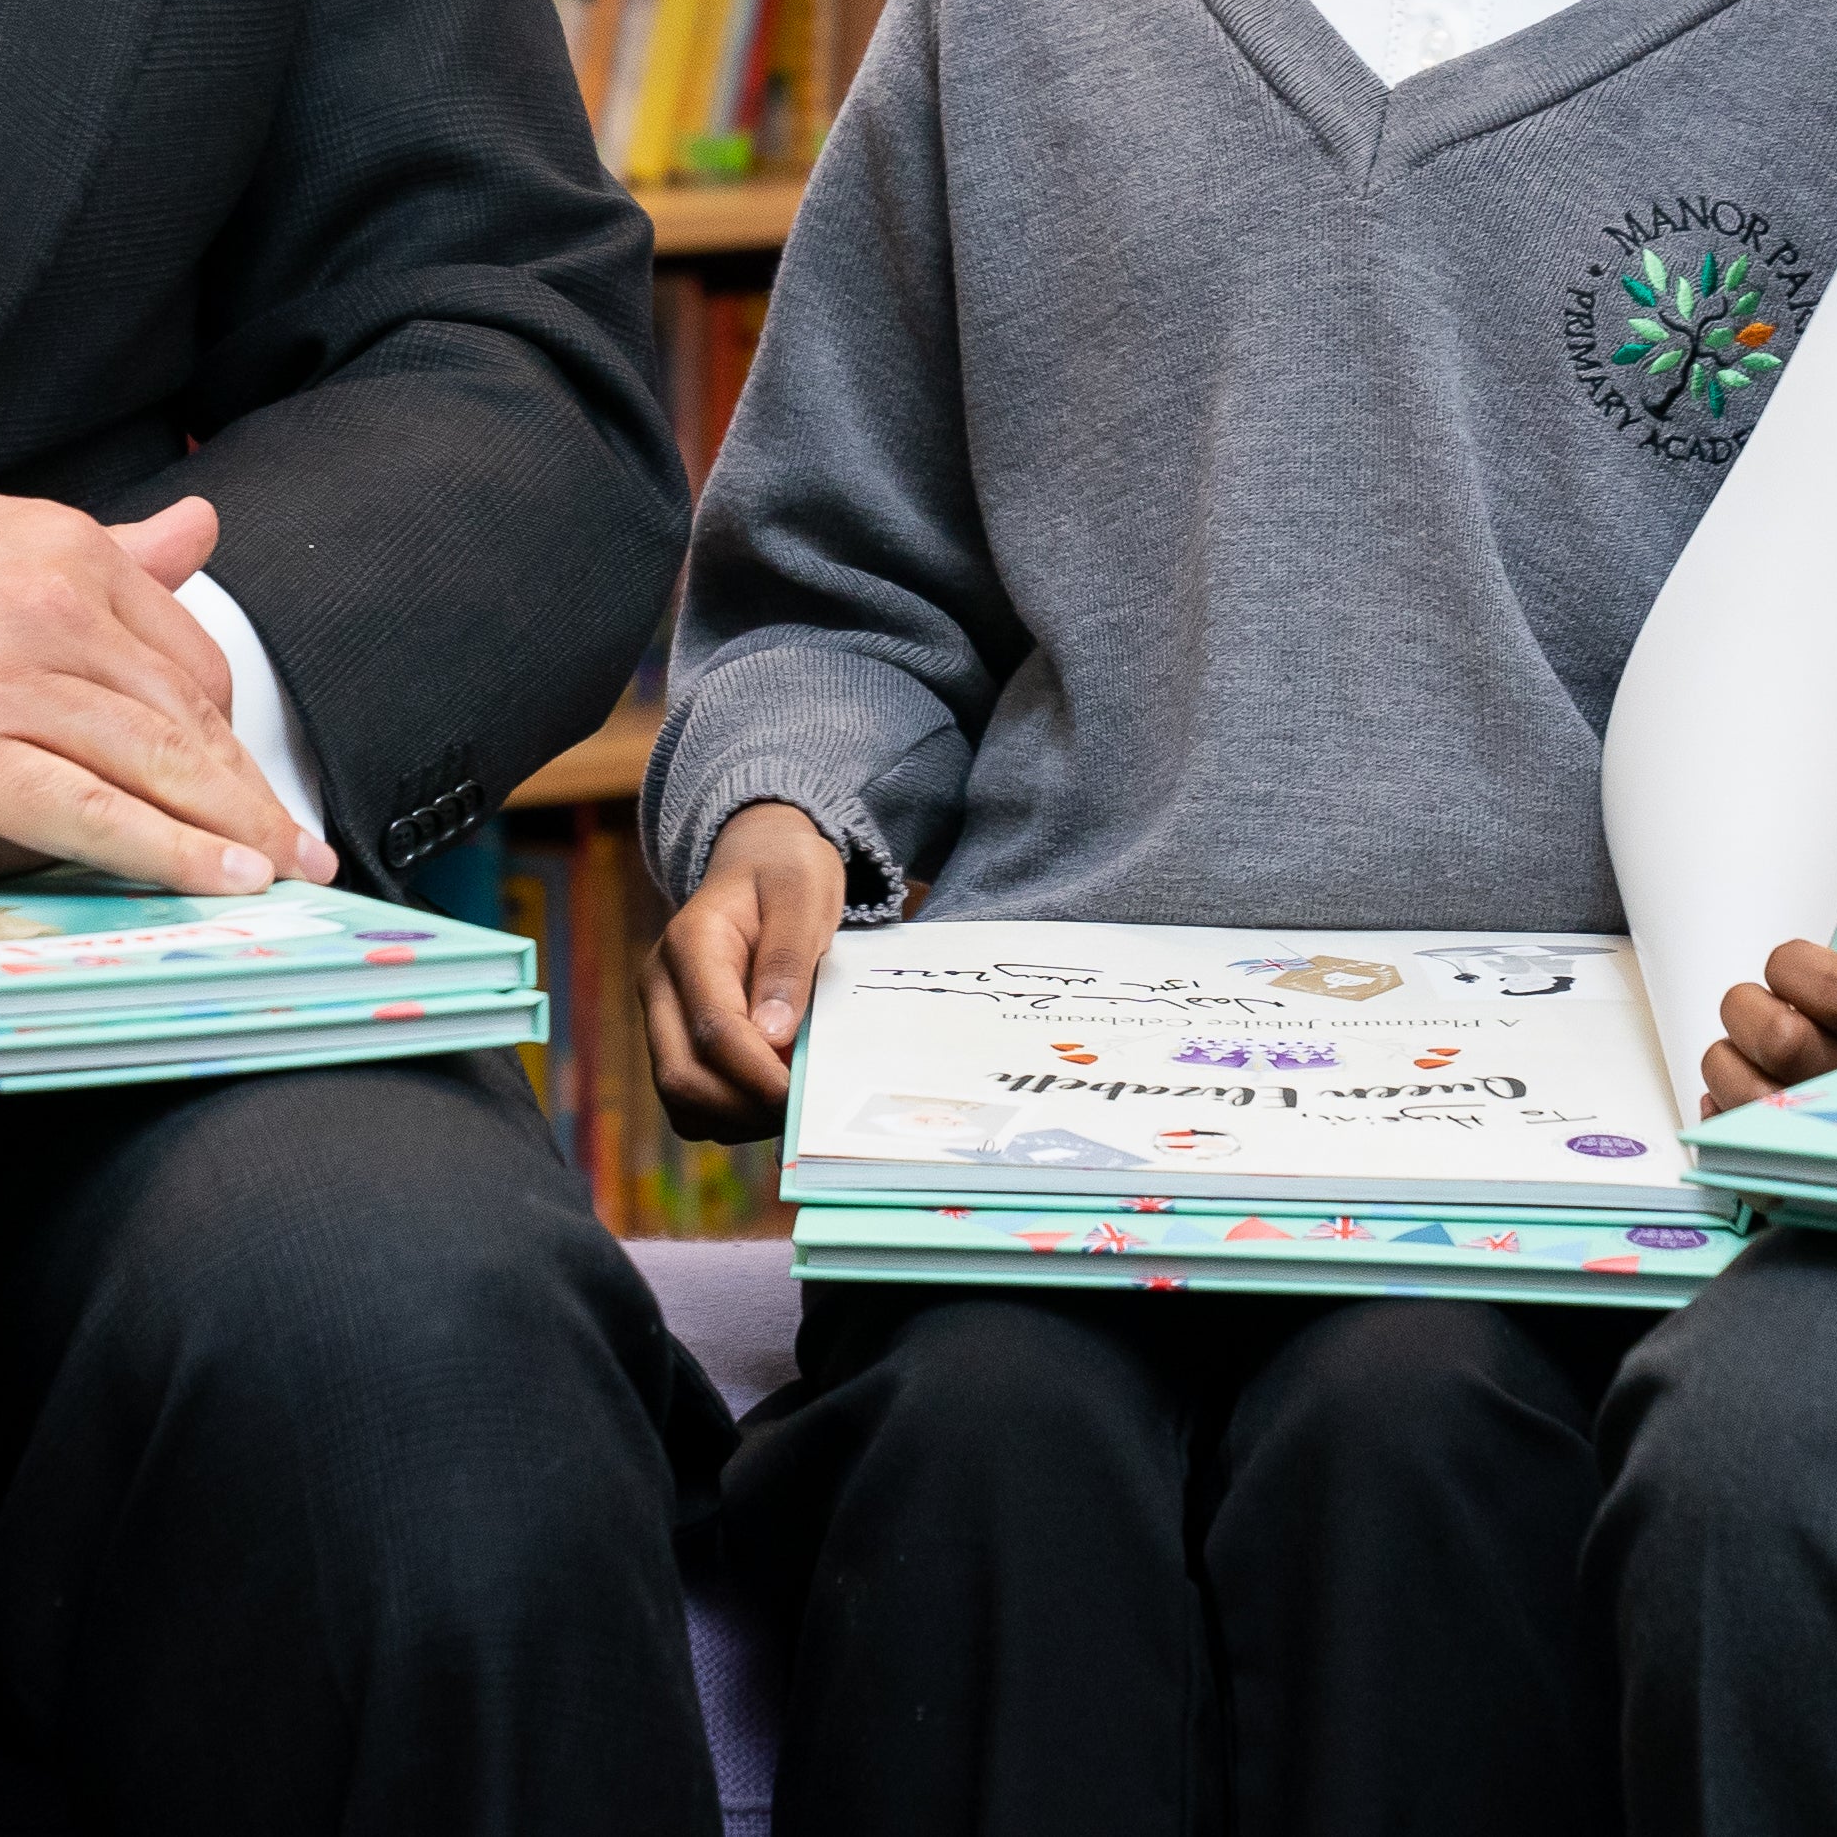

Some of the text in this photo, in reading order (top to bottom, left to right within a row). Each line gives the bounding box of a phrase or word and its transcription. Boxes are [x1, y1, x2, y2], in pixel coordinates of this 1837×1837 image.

[1602, 195, 1769, 255] MANOR
[1566, 287, 1642, 431] PRIMARY
[1001, 1013, 1523, 1030] A Platinum Jubilee Celebration
[986, 1072, 1527, 1109] Queen Elizabeth
